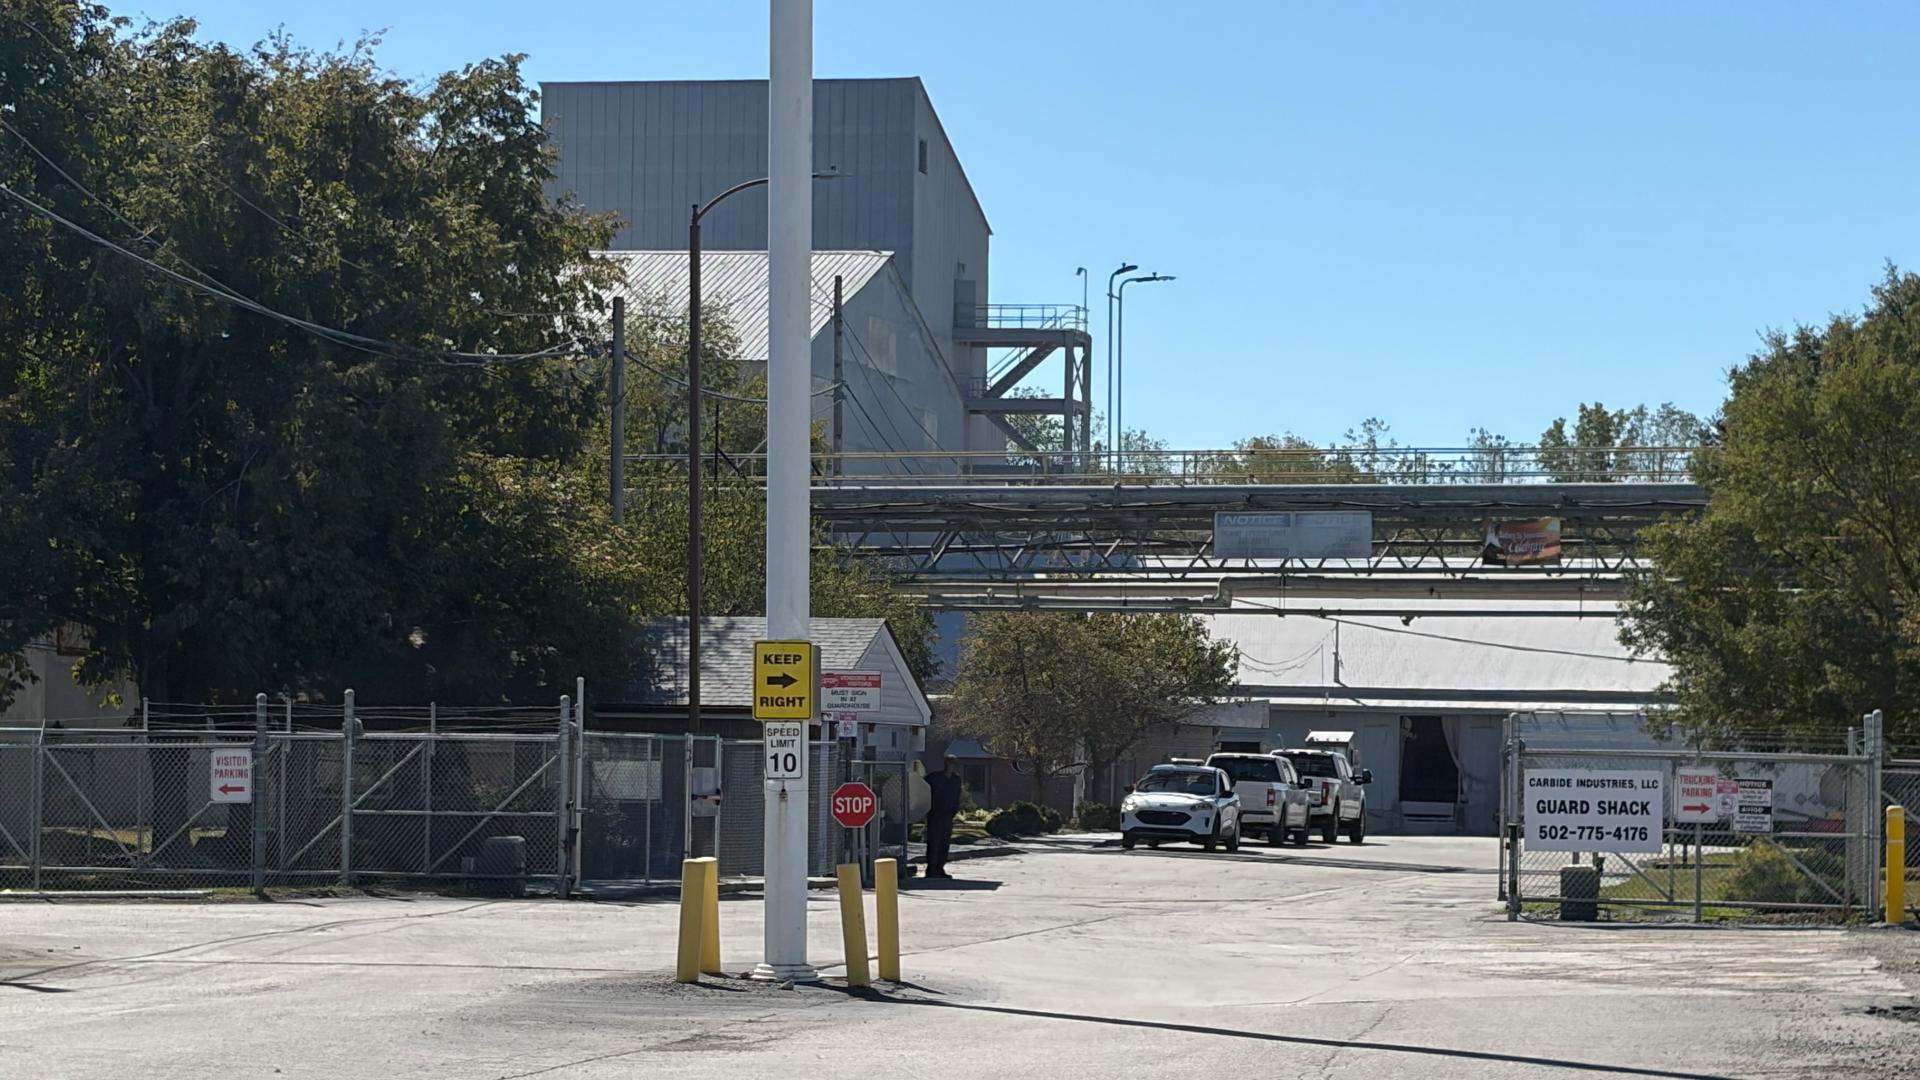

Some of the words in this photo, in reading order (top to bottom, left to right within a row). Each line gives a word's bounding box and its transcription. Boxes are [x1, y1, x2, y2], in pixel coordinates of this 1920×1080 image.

[1224, 515, 1285, 525] NOTICE
[763, 653, 802, 665] KEEP
[760, 696, 806, 708] RIGHT
[766, 728, 800, 737] SPEED
[770, 739, 796, 748] LIMIT
[216, 756, 248, 766] VISITOR
[769, 753, 797, 772] 10
[214, 769, 249, 779] PARKING
[1529, 778, 1573, 788] CARBIDE
[1576, 779, 1638, 790] INDUSTRIES,
[1641, 780, 1659, 789] LLC
[1680, 775, 1715, 785] TRUCKING
[1681, 787, 1713, 798] PARKING
[835, 796, 872, 814] STOP
[1536, 800, 1590, 814] GUARD
[1597, 800, 1651, 816] SHACK
[1538, 825, 1649, 841] 502-775-4176
